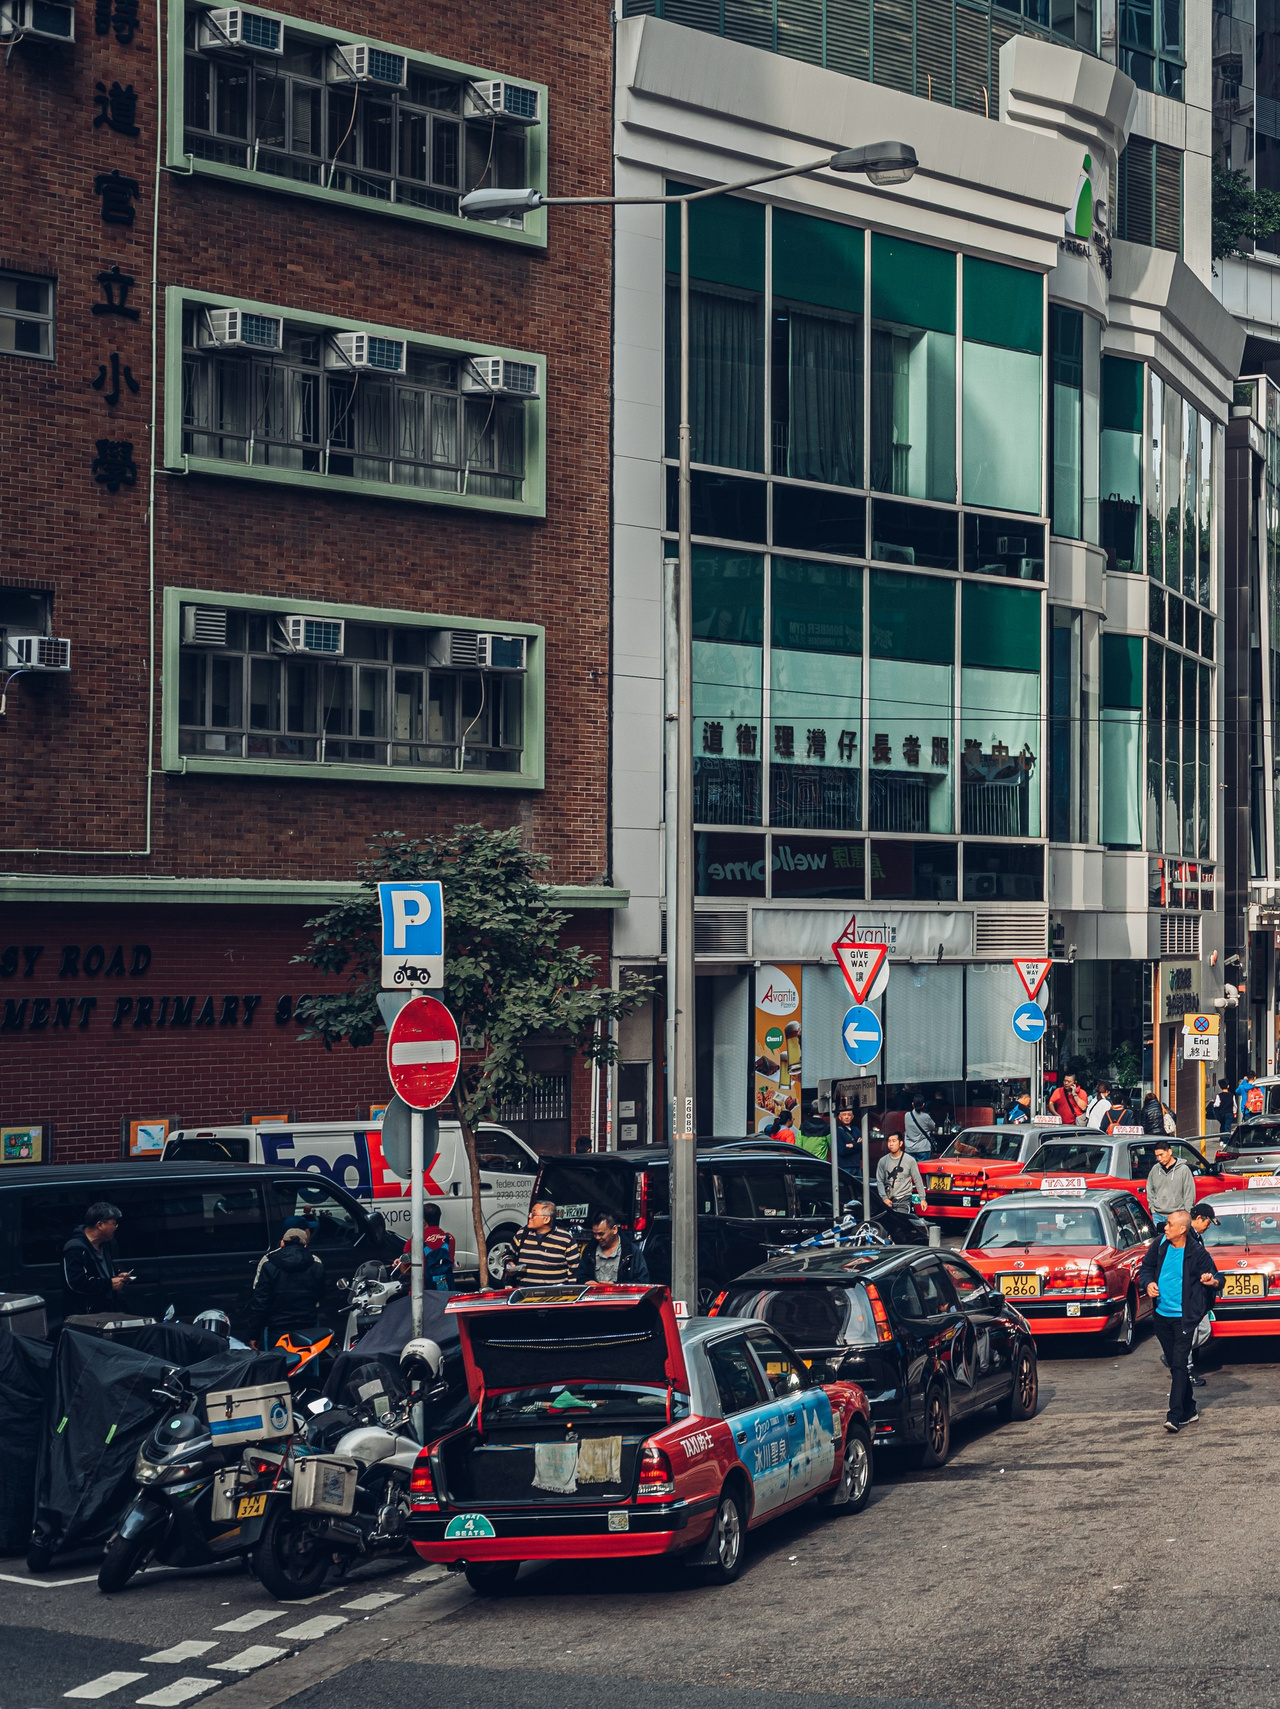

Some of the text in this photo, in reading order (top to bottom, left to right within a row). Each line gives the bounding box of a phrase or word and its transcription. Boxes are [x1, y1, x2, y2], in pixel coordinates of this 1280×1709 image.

[59, 945, 151, 977] ROAD
[761, 984, 793, 1004] Avanti
[112, 995, 261, 1028] PRIMARY
[1194, 1037, 1209, 1045] End
[862, 1081, 876, 1089] Road
[496, 1178, 531, 1189] fedex.com
[1045, 1178, 1082, 1187] TAXI
[373, 1206, 412, 1225] Expre
[1013, 1276, 1028, 1286] VU
[1235, 1275, 1251, 1285] KR
[1005, 1286, 1036, 1296] 2860
[1227, 1285, 1260, 1295] 2358
[241, 1505, 260, 1516] 374
[464, 1520, 475, 1531] 4
